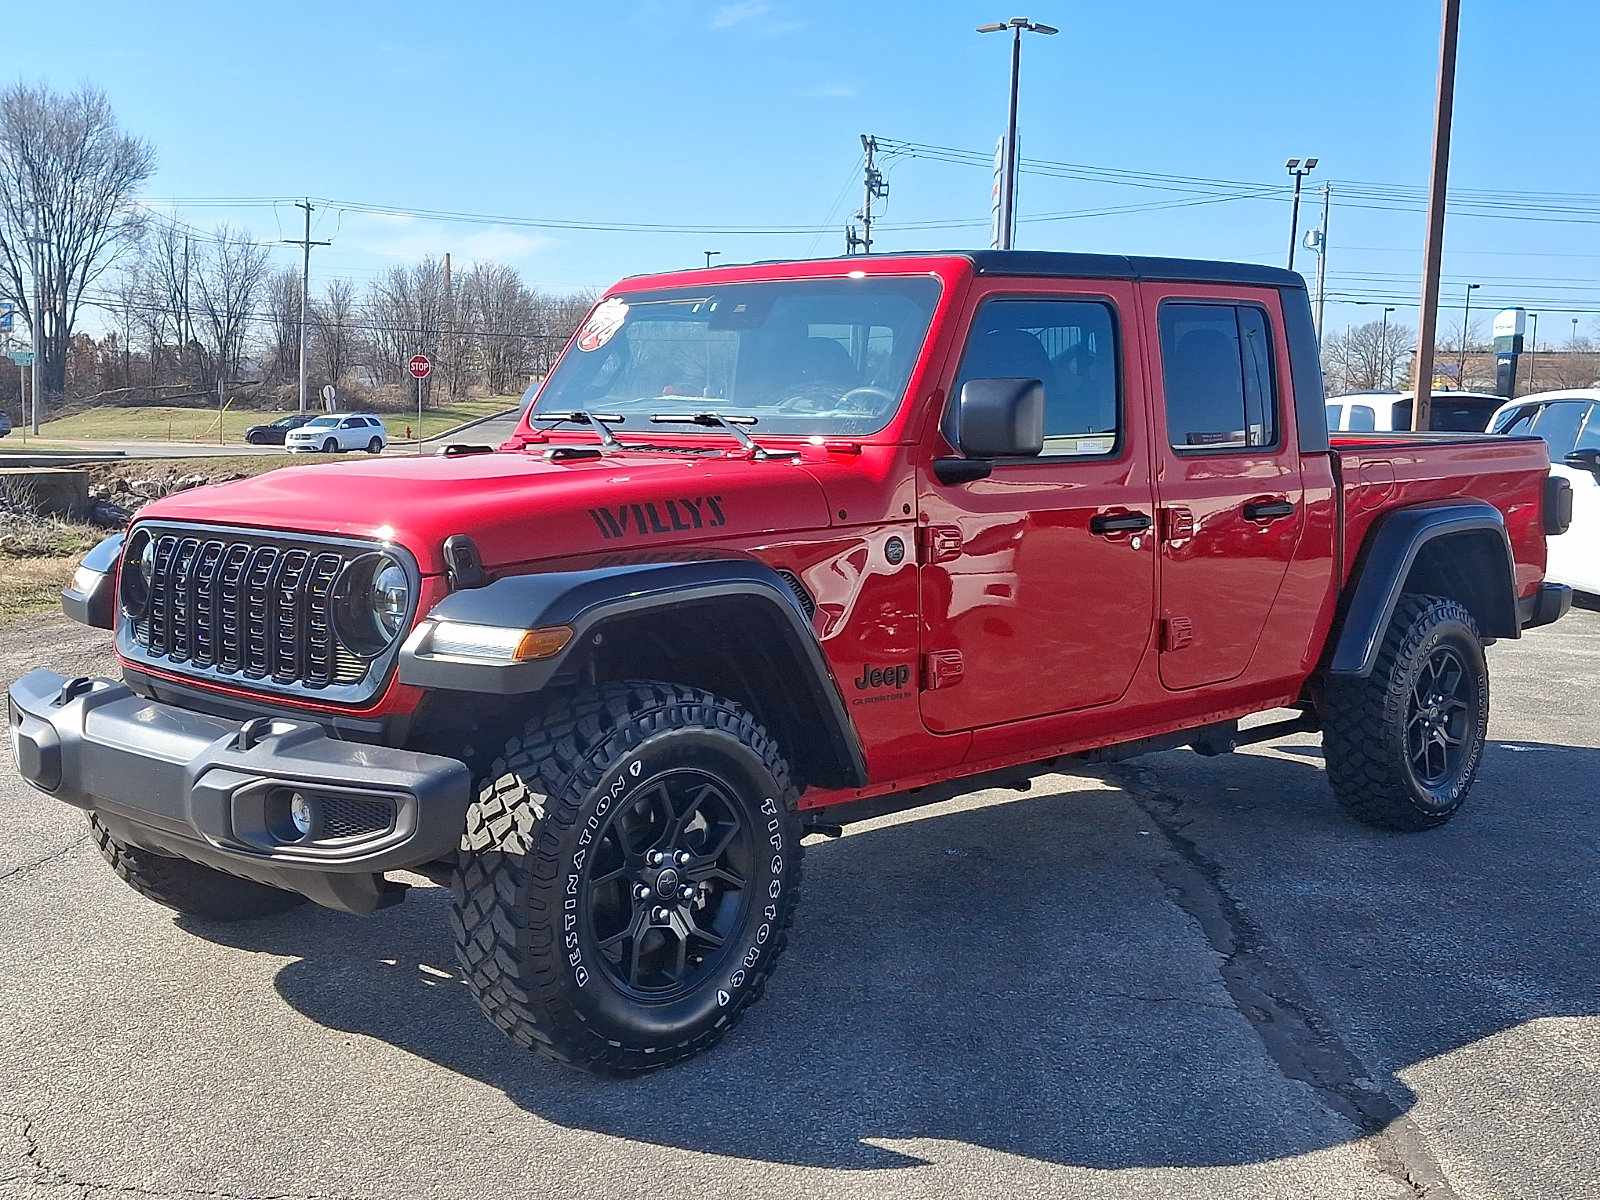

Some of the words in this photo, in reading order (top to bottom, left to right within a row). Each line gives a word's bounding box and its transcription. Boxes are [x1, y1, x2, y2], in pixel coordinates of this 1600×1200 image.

[410, 361, 429, 371] STOP
[587, 496, 726, 539] WILLYS
[854, 663, 910, 690] Jeep
[564, 774, 626, 988] DESTINATION
